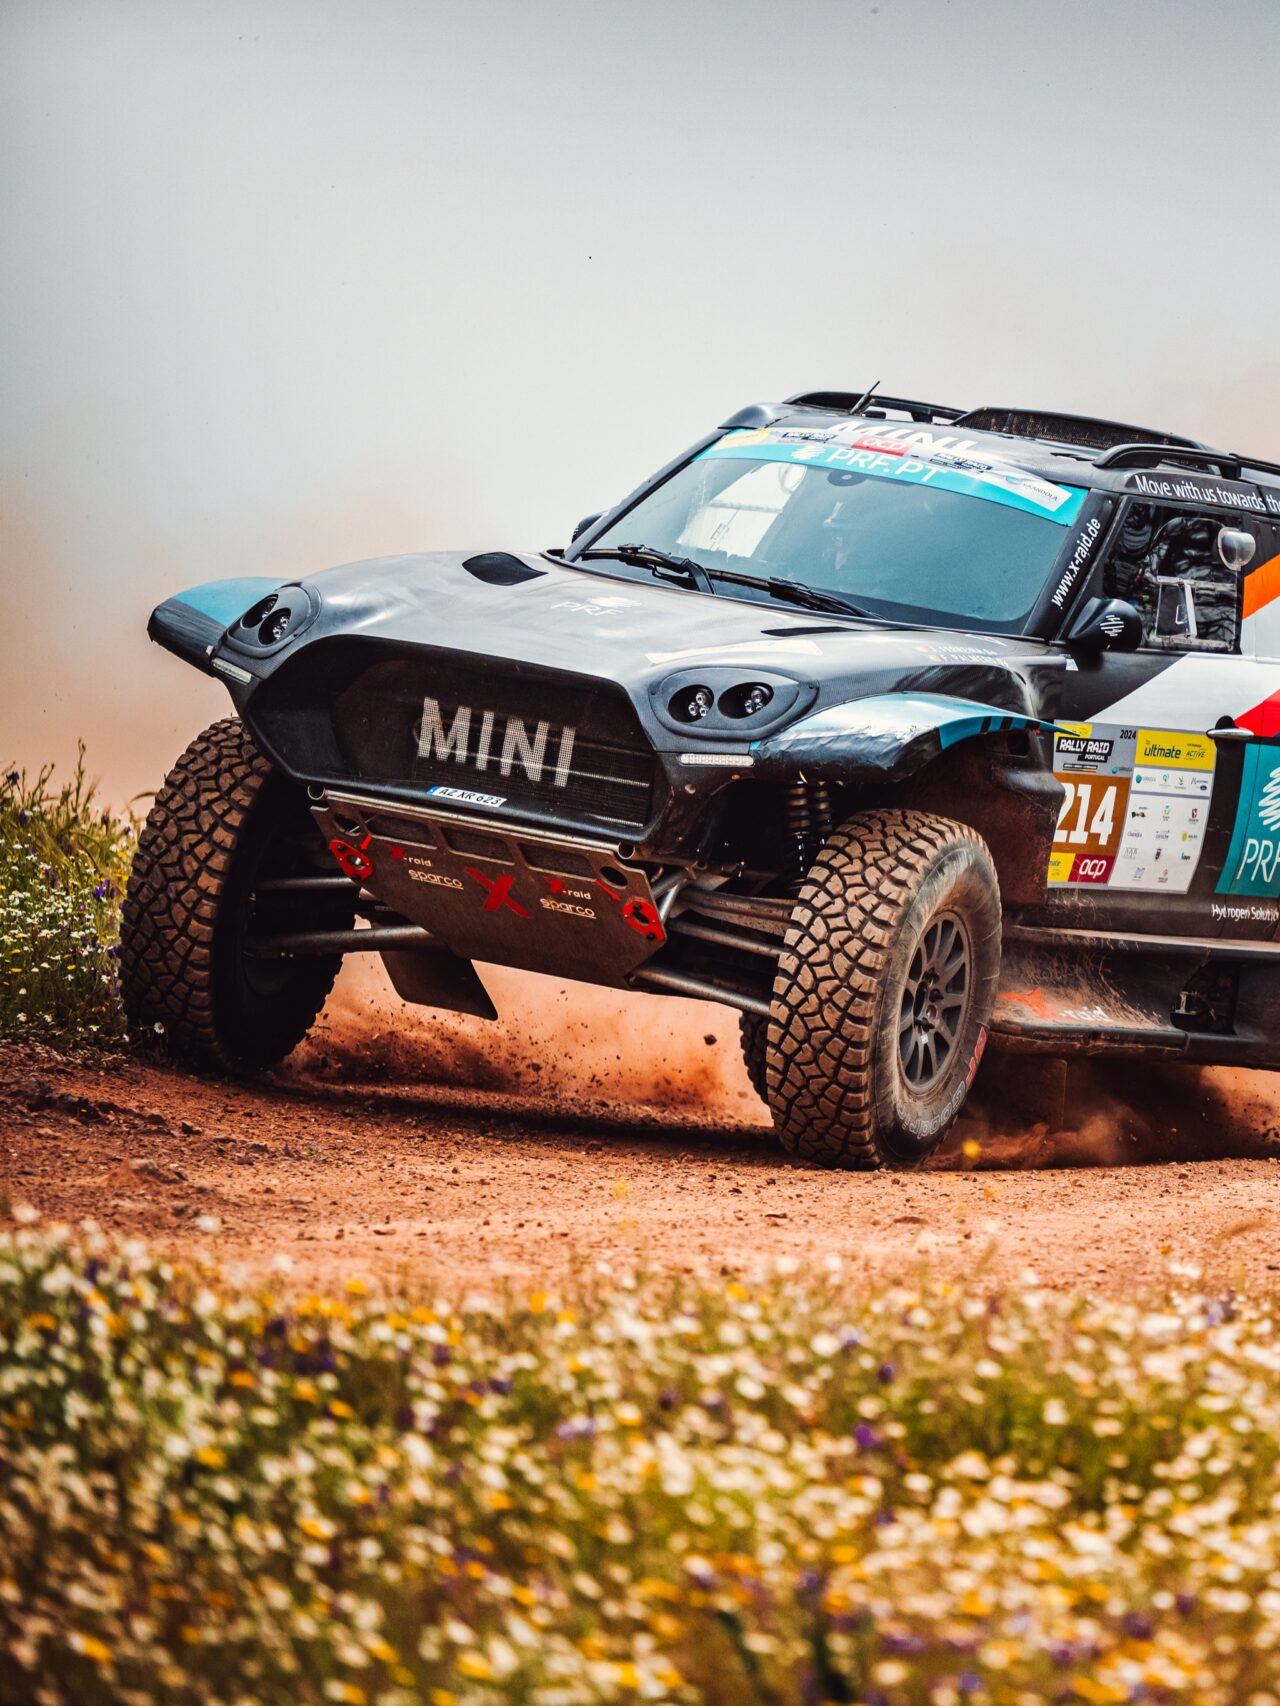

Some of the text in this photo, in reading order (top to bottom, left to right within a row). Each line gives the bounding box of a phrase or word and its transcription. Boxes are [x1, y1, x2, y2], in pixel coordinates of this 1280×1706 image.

[861, 437, 906, 451] acp
[826, 448, 948, 482] PRF.PT
[1135, 474, 1172, 496] Move
[1172, 480, 1201, 500] with
[1202, 487, 1217, 503] us
[1217, 487, 1266, 514] towards
[1051, 517, 1101, 607] www.x-raid.de
[551, 601, 625, 616] PRF
[416, 696, 576, 788] MINI
[1120, 729, 1137, 739] 2024
[1059, 739, 1110, 754] RALLY RAID
[1144, 743, 1182, 759] ultimate
[1185, 750, 1206, 758] ACTIVE
[1084, 753, 1106, 761] PORTUGAL
[439, 788, 502, 805] AZ XR 623
[1053, 782, 1117, 845] 214
[408, 869, 463, 888] sparco
[1079, 859, 1107, 879] acp
[540, 898, 596, 917] sparco
[1211, 903, 1251, 922] Hydrogen
[896, 1026, 988, 1140] BFGoodric
